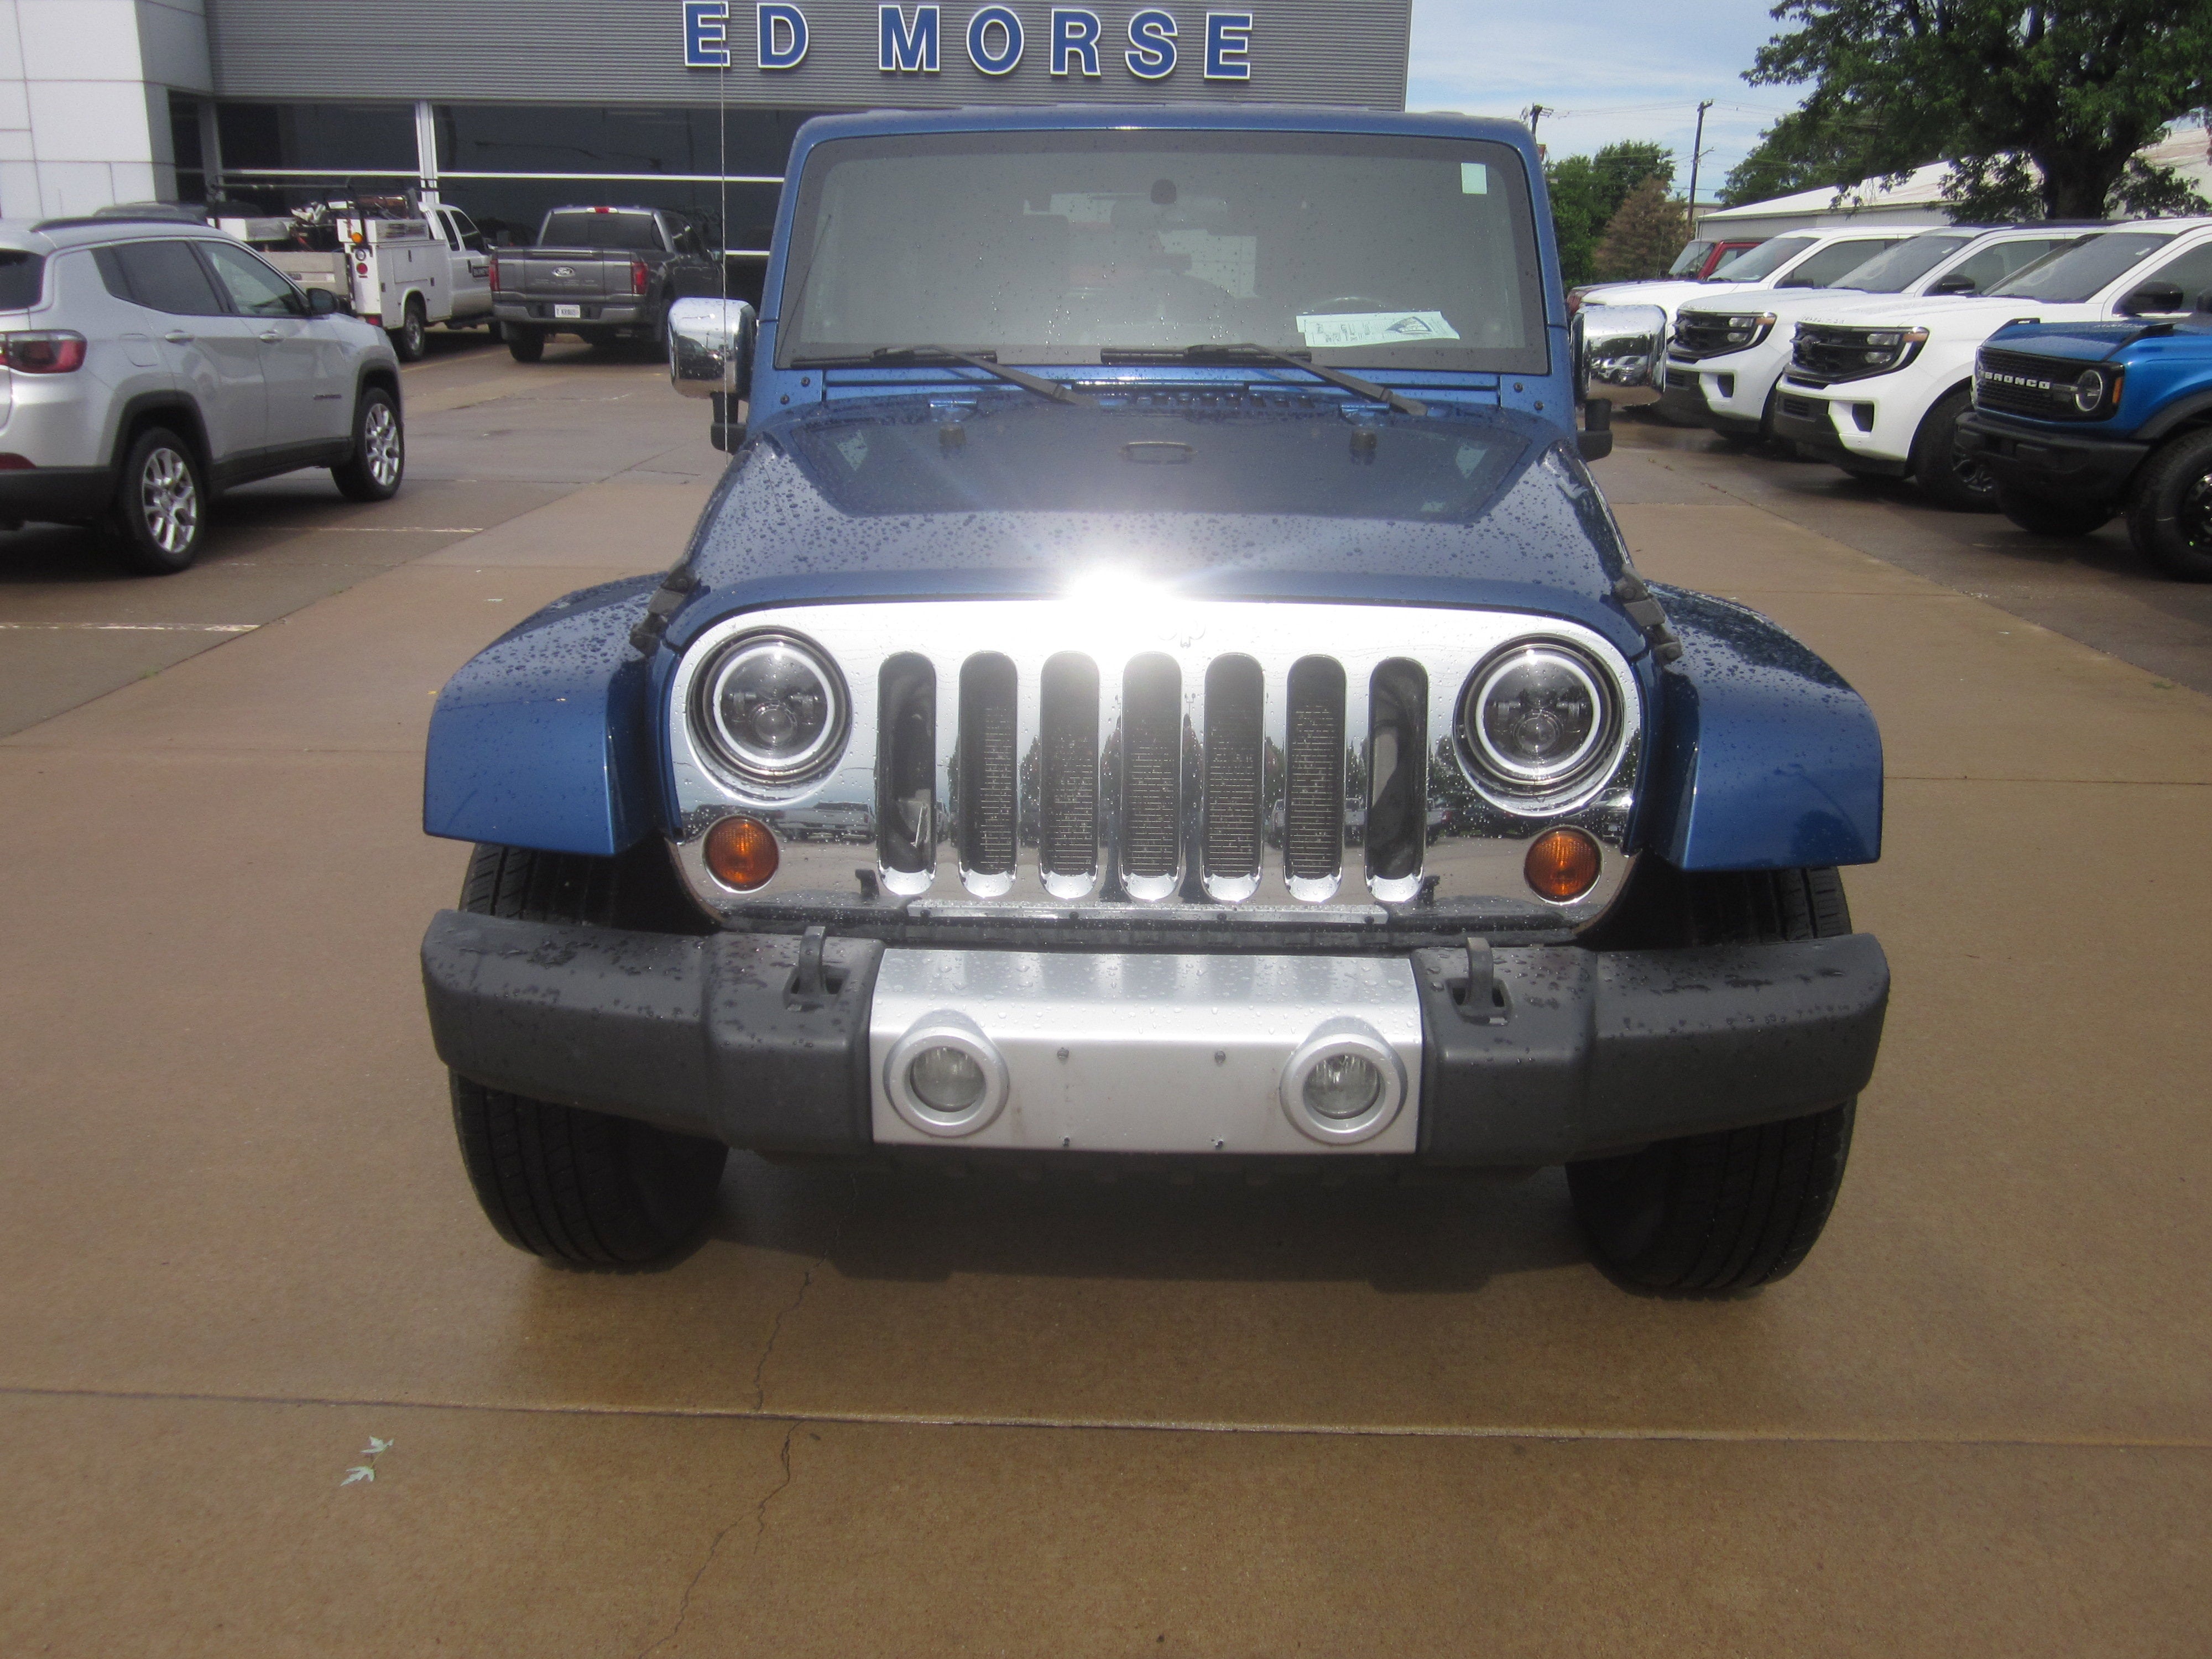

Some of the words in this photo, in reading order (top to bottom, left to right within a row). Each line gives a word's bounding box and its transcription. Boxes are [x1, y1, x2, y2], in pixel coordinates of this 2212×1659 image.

[682, 1, 810, 69] ED
[878, 4, 1254, 79] MORSE
[1984, 371, 2051, 390] BRONCO
